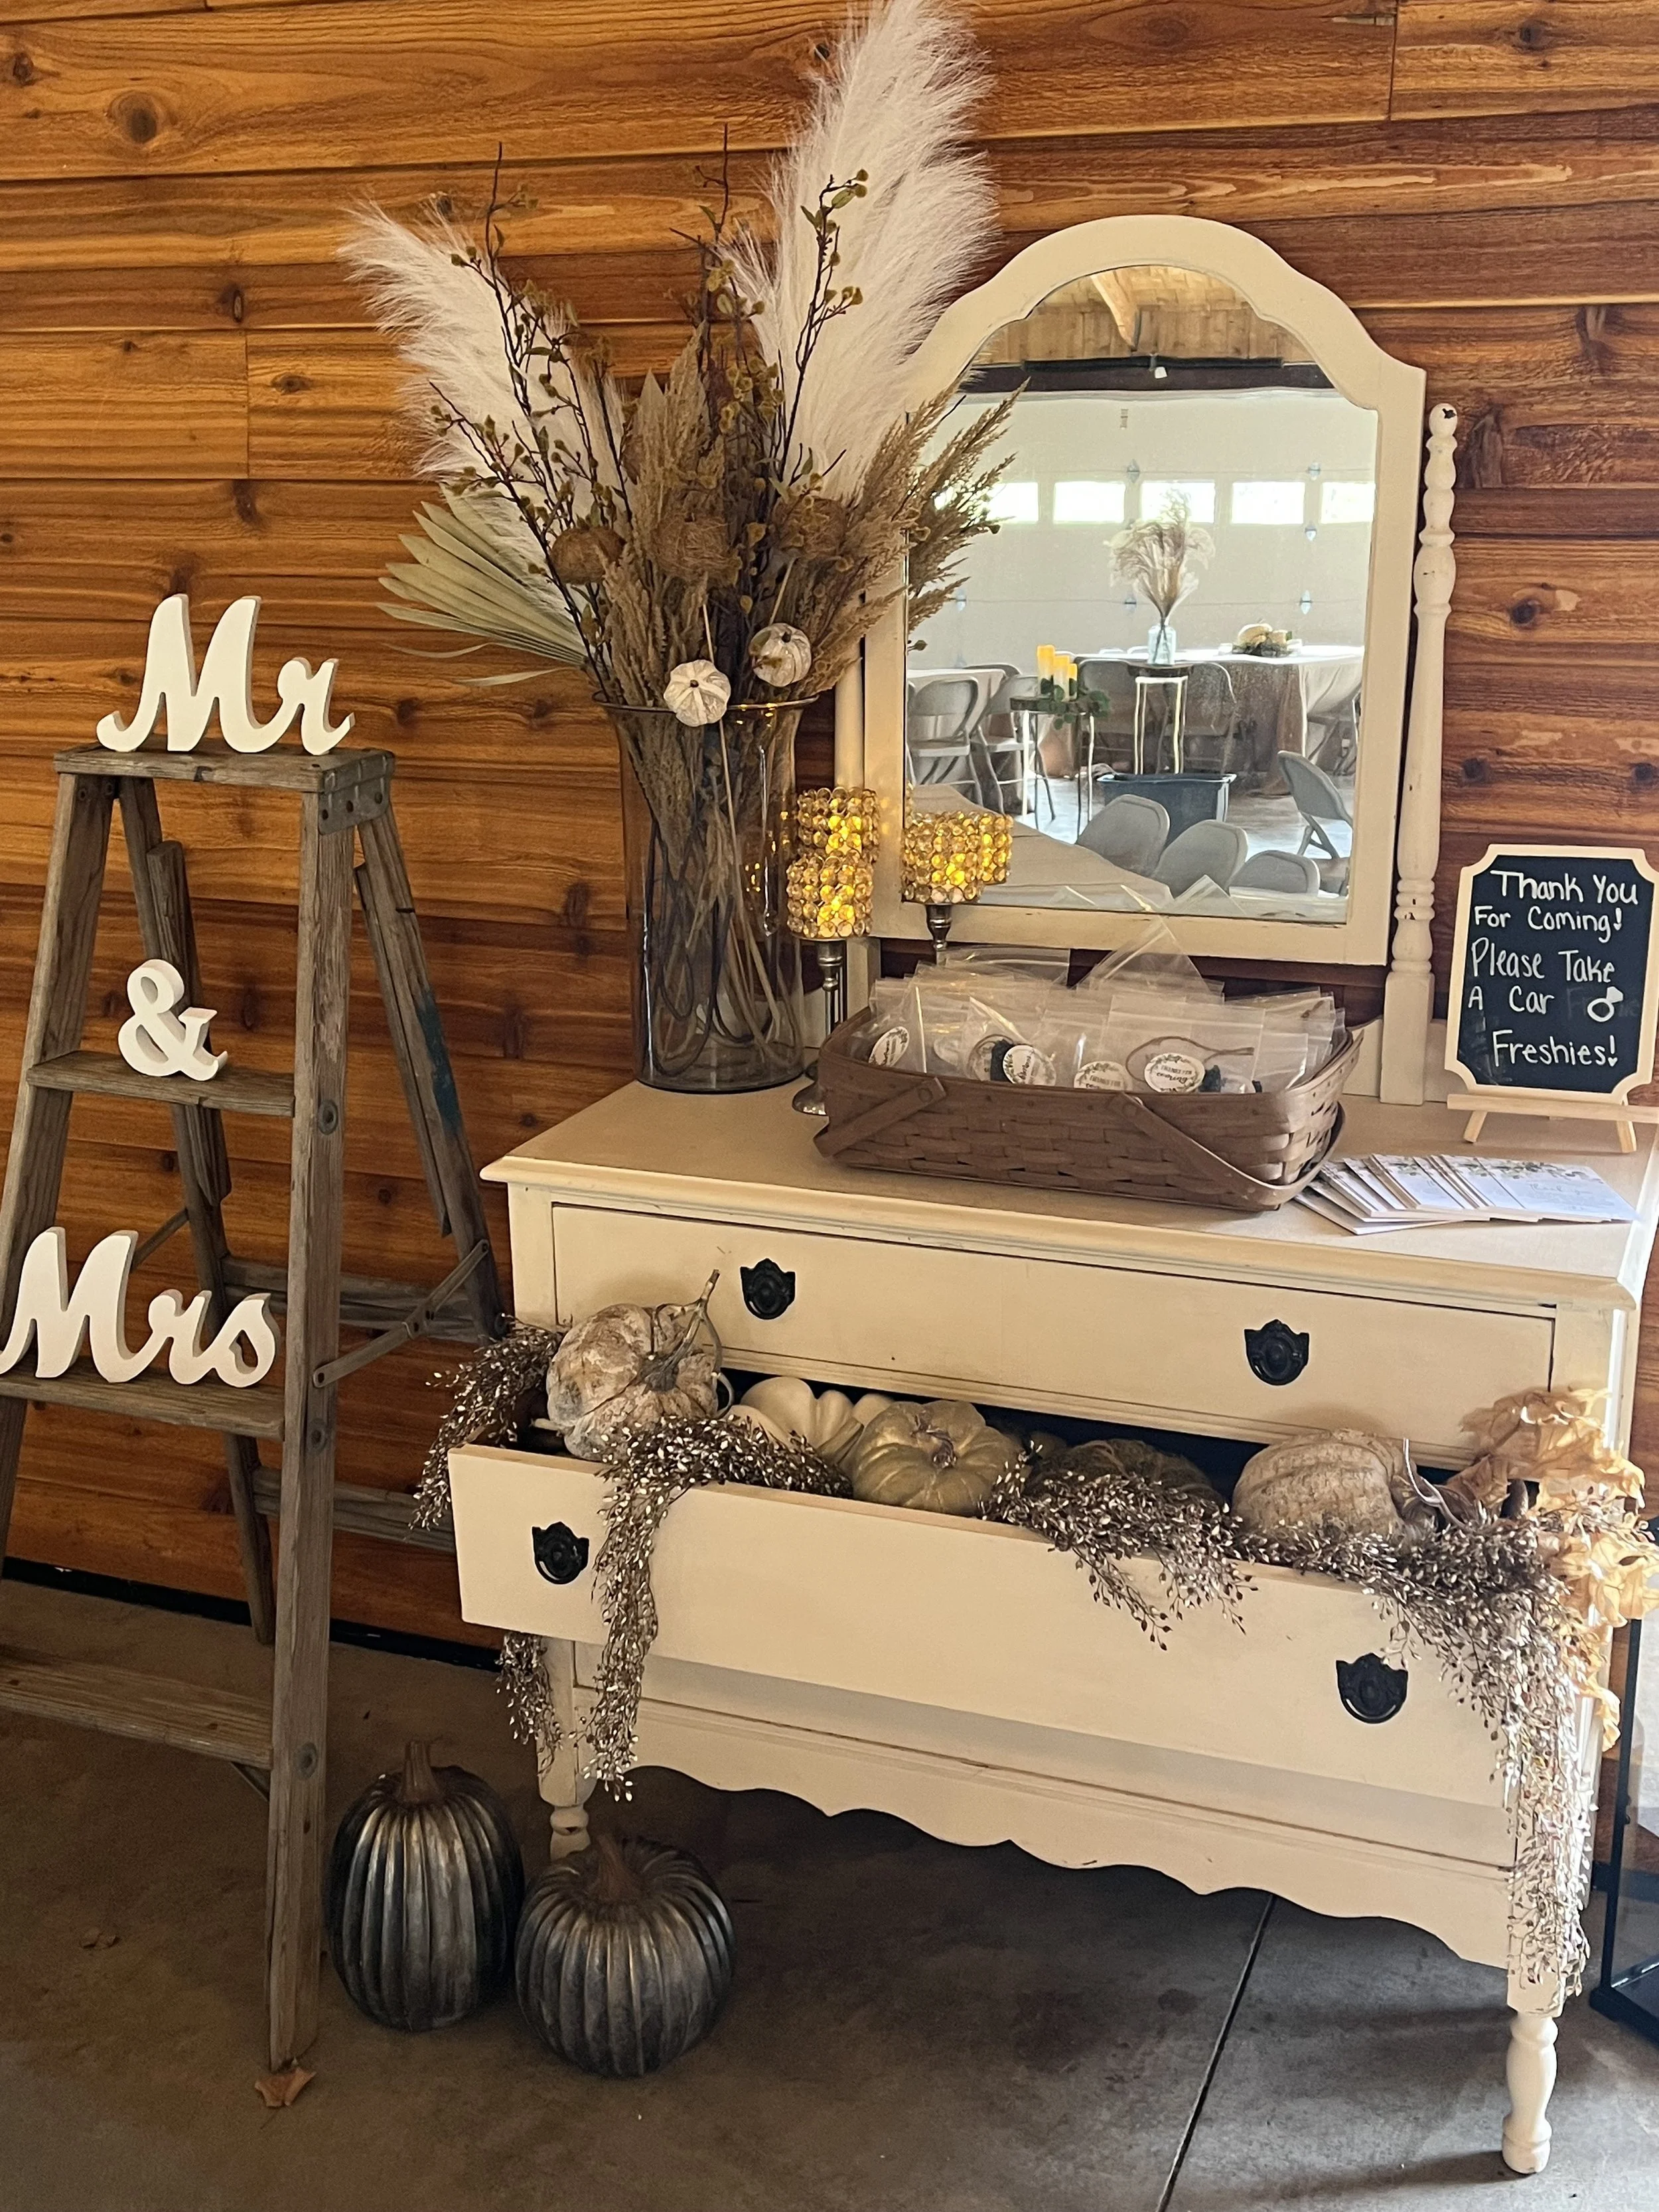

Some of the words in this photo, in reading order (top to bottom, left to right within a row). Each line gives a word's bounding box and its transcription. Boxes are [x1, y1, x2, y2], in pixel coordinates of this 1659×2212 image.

[96, 594, 355, 755] Mr
[1490, 869, 1583, 903] Thank
[1593, 873, 1638, 905] You
[1474, 905, 1512, 928] For
[1528, 905, 1623, 944] Coming!
[1471, 936, 1545, 979] Please
[1557, 949, 1615, 984] Take
[118, 959, 228, 1081] &
[1467, 986, 1483, 1011] A
[1508, 986, 1555, 1014] Car
[1492, 1029, 1618, 1067] Freshies!
[0, 1226, 281, 1388] Mrs
